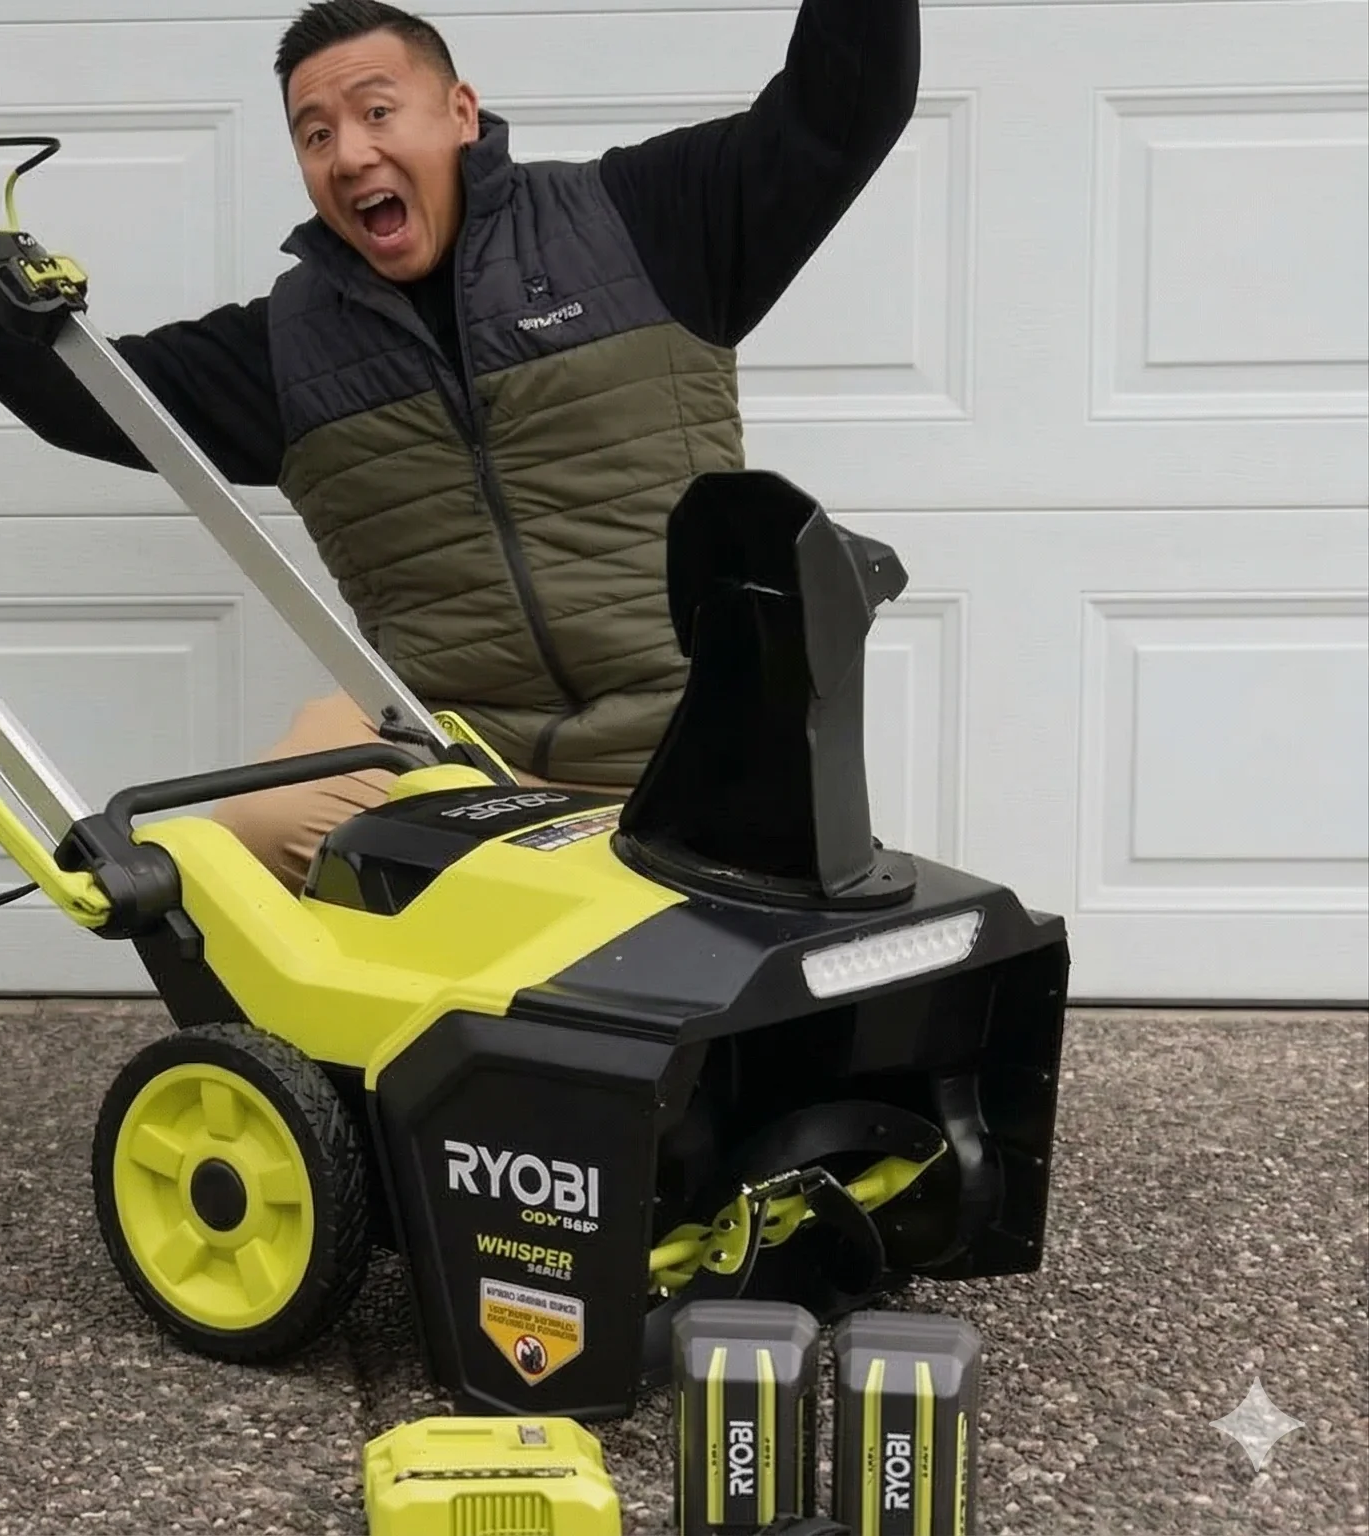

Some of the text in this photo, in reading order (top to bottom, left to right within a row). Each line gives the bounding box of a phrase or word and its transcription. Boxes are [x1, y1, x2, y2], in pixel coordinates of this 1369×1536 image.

[444, 1139, 599, 1217] RYOBI
[476, 1234, 574, 1270] WHISPER
[729, 1421, 754, 1496] RYOBI
[885, 1433, 911, 1510] RYOBI
